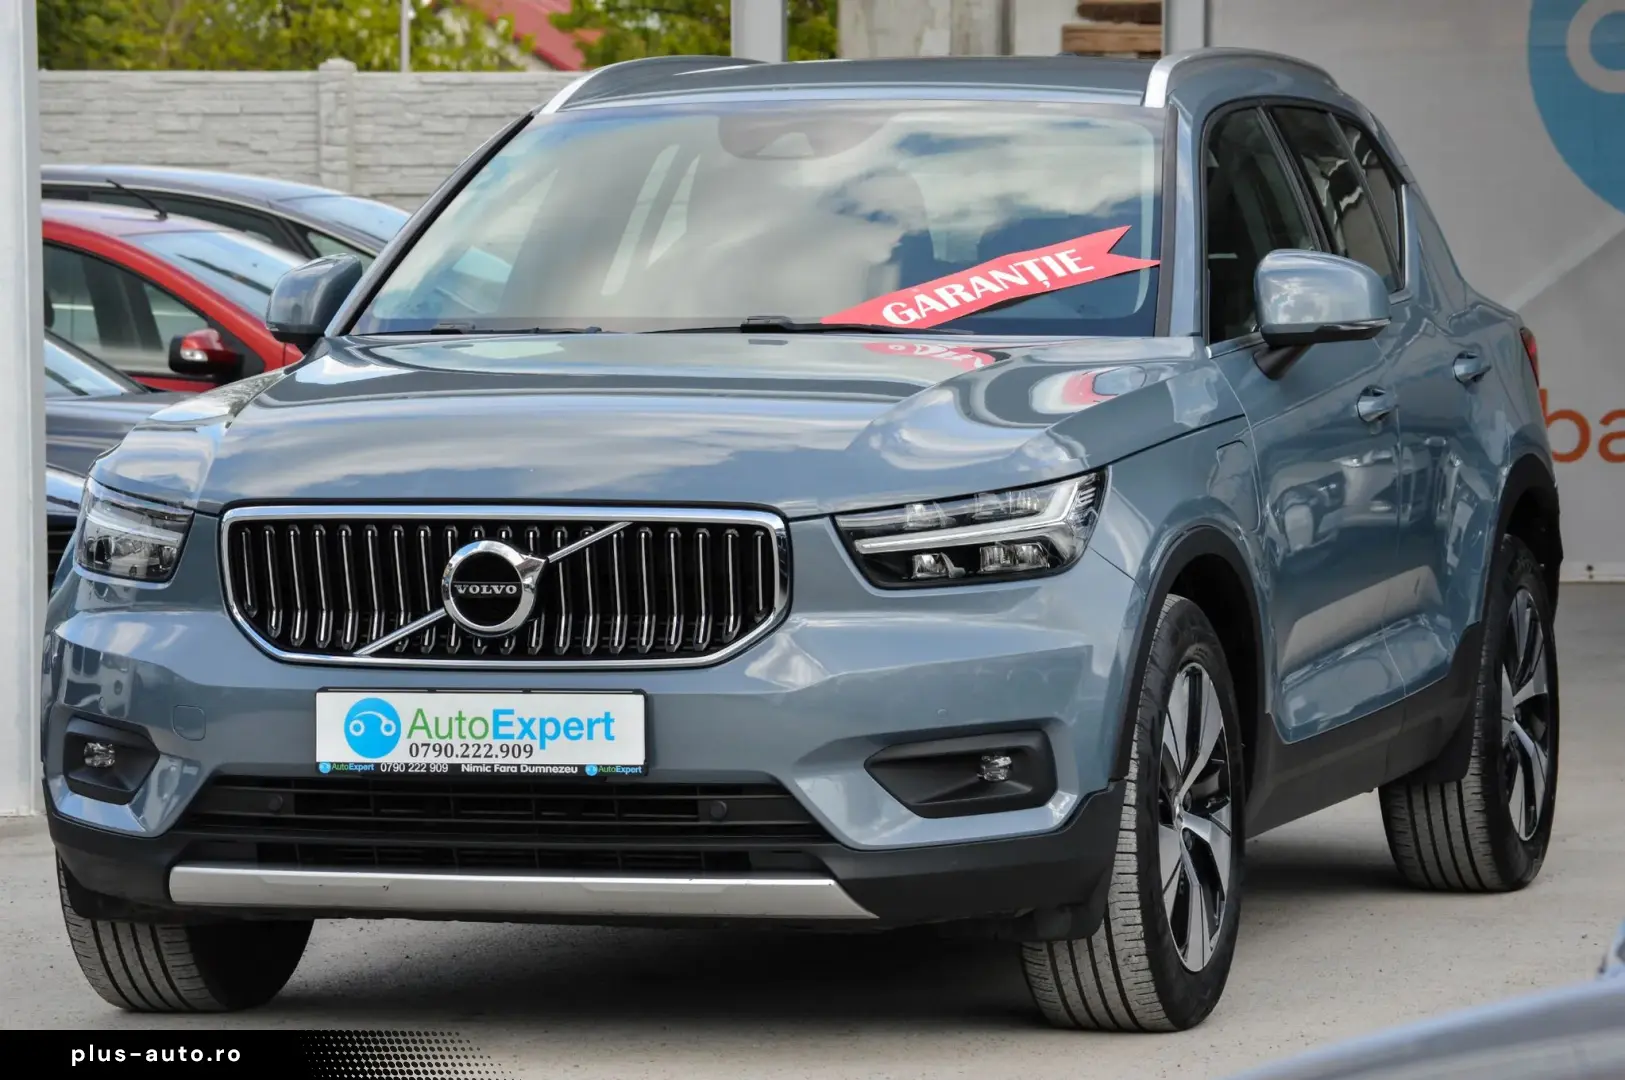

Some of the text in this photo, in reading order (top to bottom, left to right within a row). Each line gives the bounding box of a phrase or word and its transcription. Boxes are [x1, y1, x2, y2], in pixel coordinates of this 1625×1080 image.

[881, 248, 1095, 326] GARANȚIE
[454, 584, 517, 594] VOLVO
[406, 708, 615, 750] AutoExpert
[409, 742, 534, 758] 0790.222.909
[331, 763, 642, 775] AutoExpert 0790 222 909 Nimic Fara Dumnezeu AutoExpert
